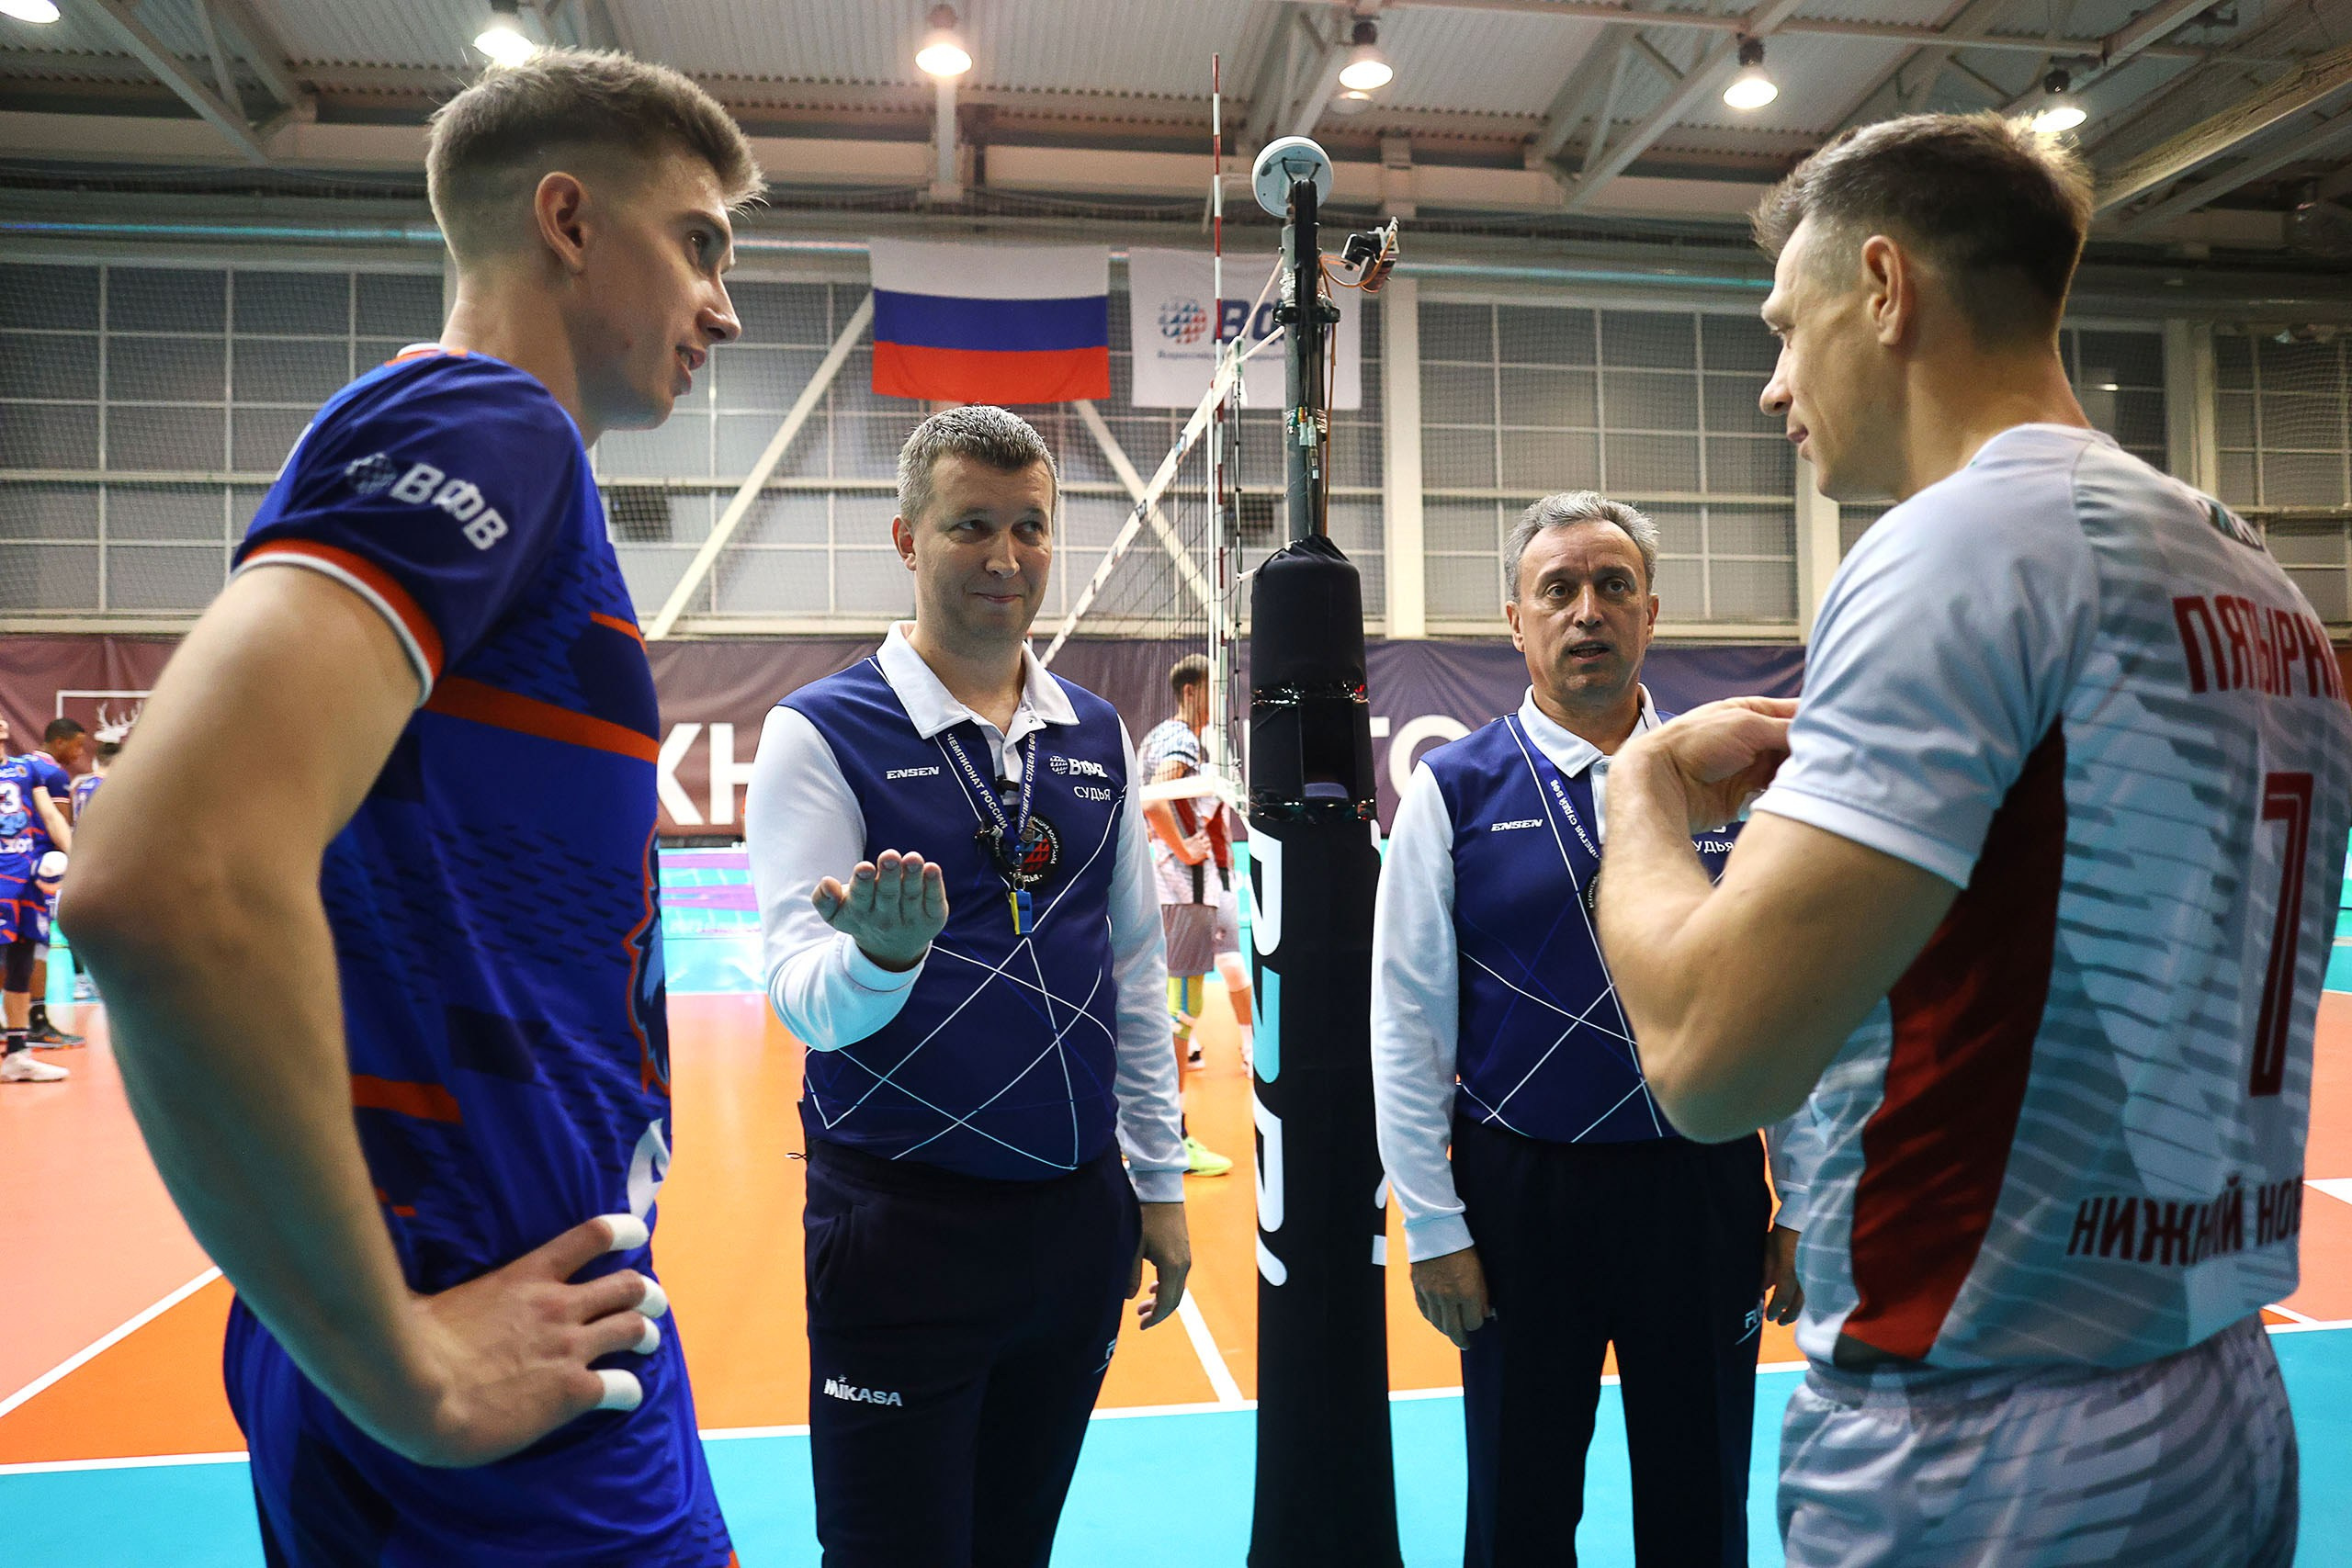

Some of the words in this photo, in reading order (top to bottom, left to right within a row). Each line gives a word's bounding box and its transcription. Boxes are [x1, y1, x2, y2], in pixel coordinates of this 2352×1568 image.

[390, 462, 509, 550] ВФВ
[886, 766, 940, 780] ENSEN
[1025, 751, 1035, 783] СУДЕЙ
[947, 733, 985, 789] ЧЕМПИОНАТ
[979, 789, 1008, 829] РОССИИ
[1073, 785, 1111, 802] СУДЬЯ
[1490, 818, 1544, 832] ENSEN
[1691, 840, 1735, 854] УДЬЯ
[823, 1374, 903, 1406] MIKASA
